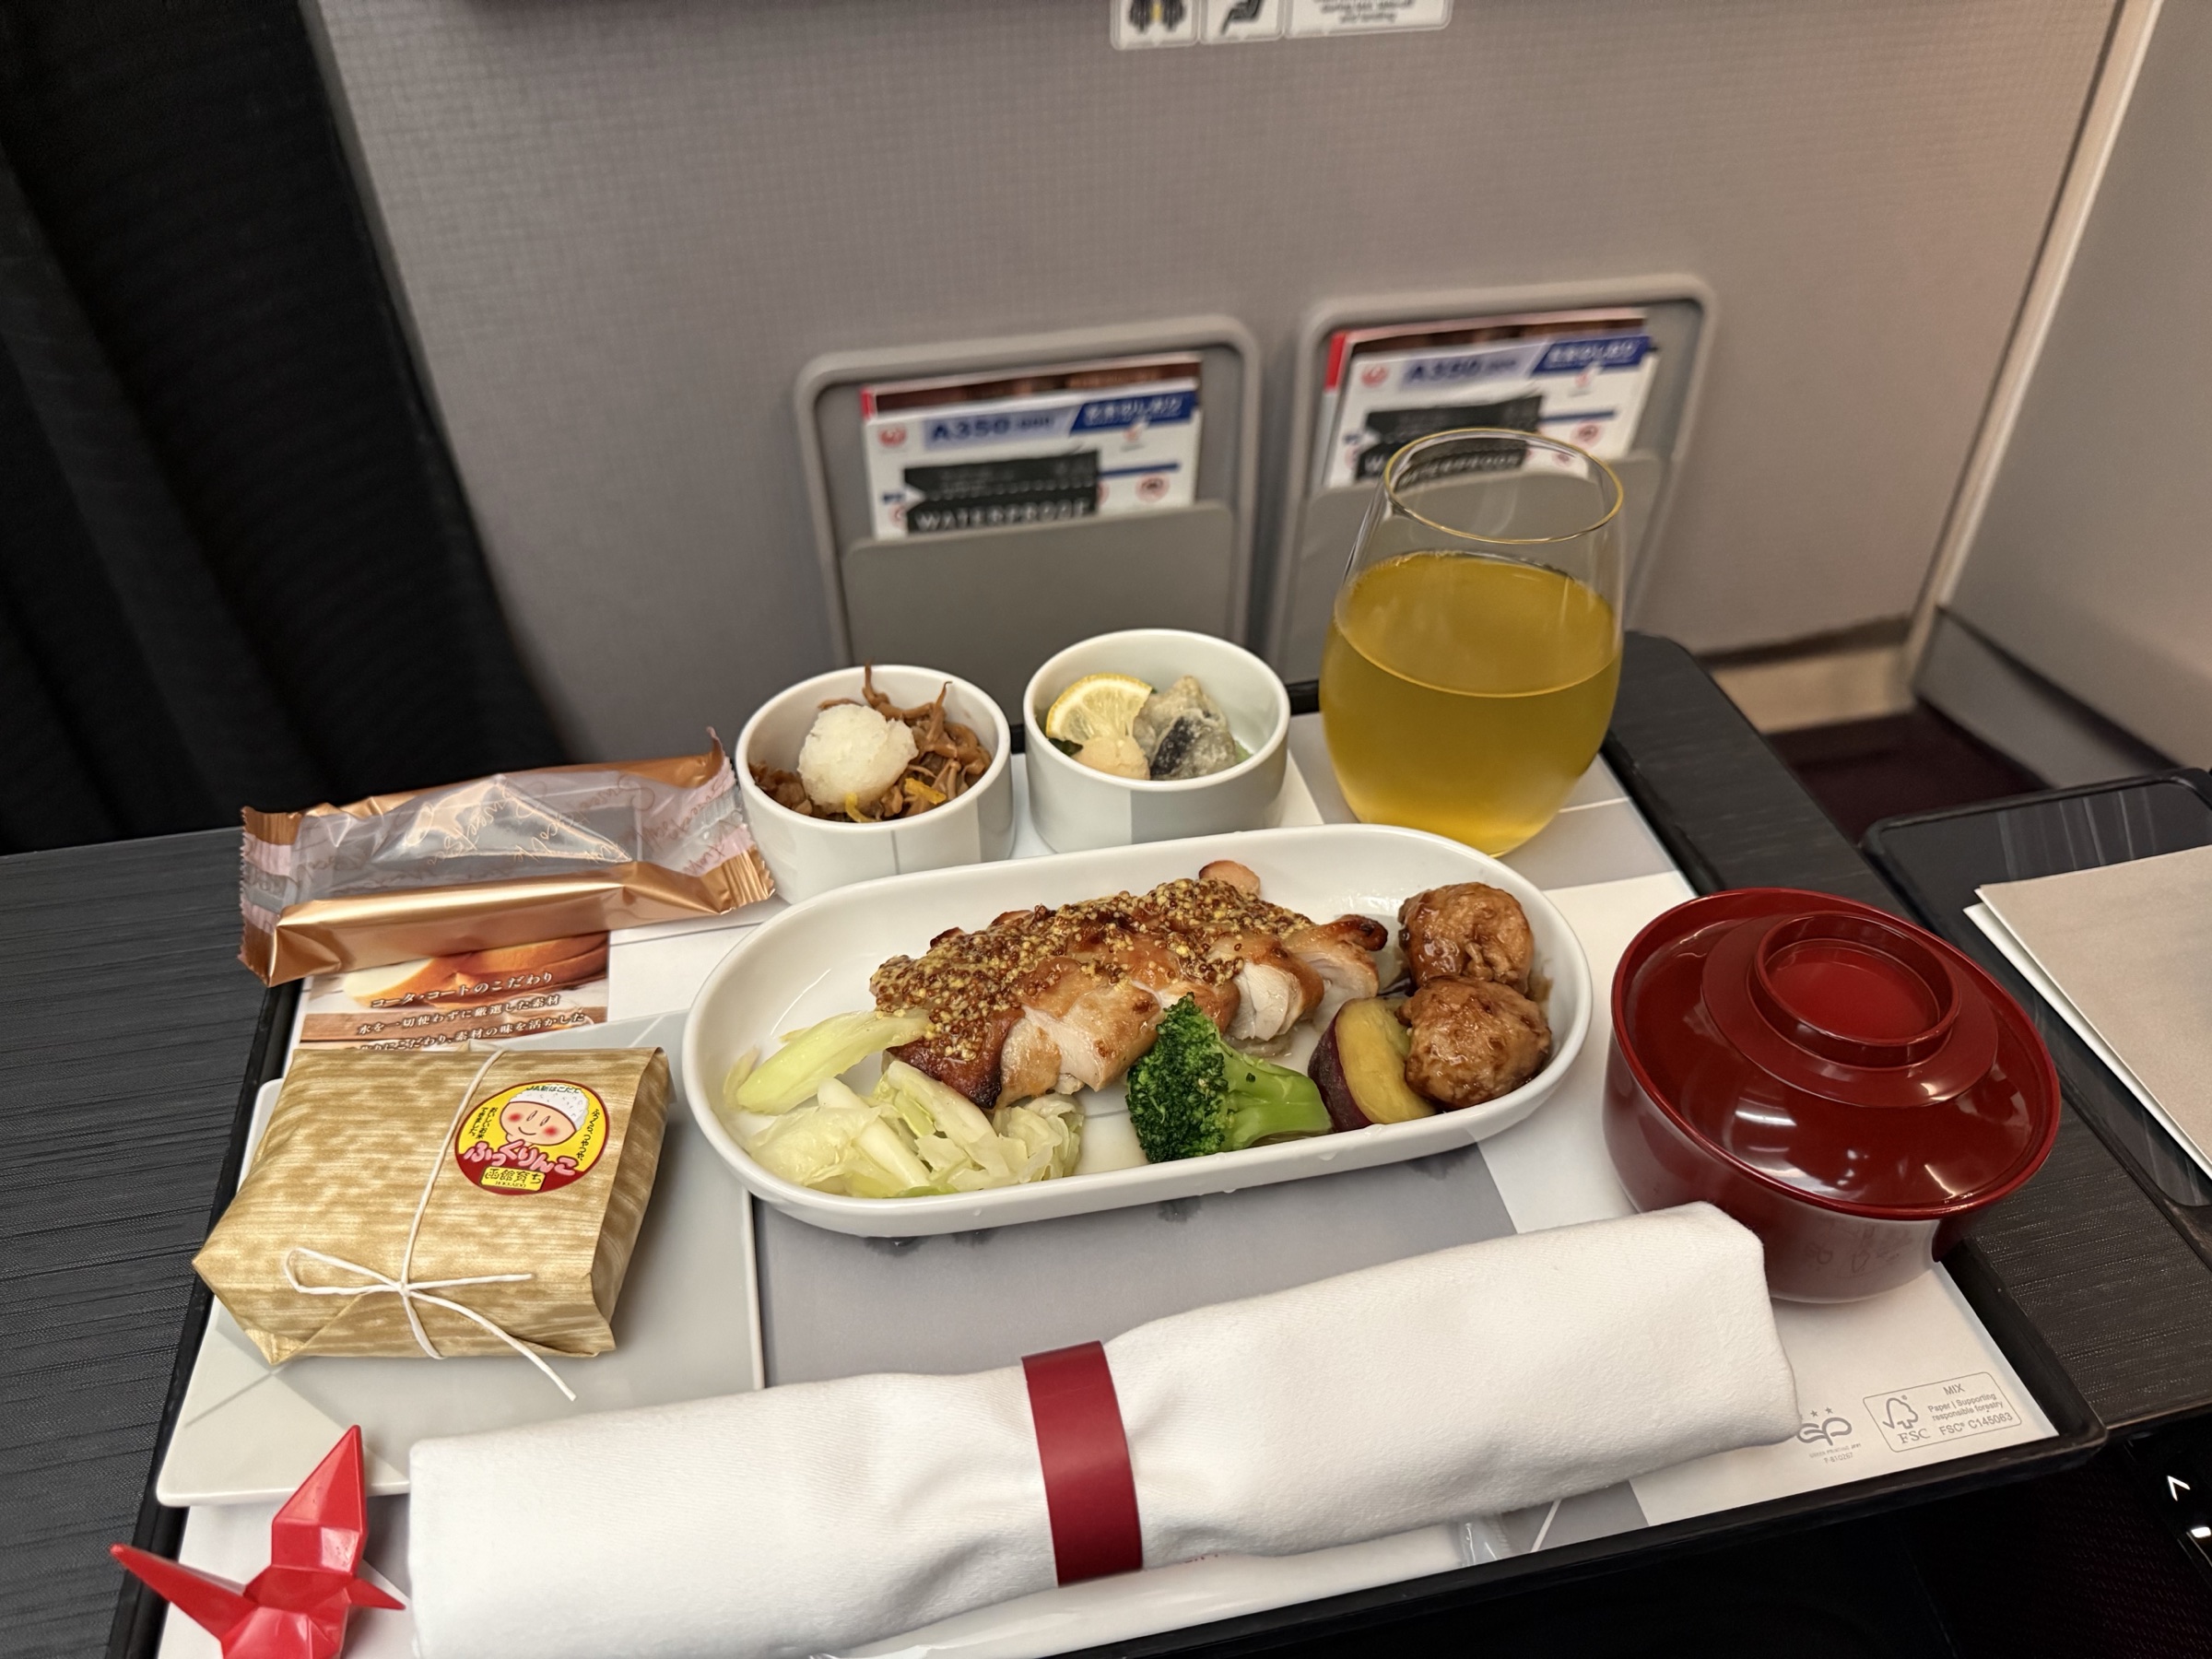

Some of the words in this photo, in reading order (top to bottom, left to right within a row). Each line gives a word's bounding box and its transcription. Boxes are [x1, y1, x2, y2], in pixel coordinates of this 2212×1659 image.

[371, 972, 553, 1008] コータ・コートのこだわり
[358, 994, 560, 1035] 水を一切使わずに厳選した素材
[464, 1139, 578, 1176] ふっくりんこ
[484, 1168, 542, 1184] 函館育ち
[1943, 1383, 1965, 1395] MIX
[1927, 1402, 1951, 1413] Paper
[1956, 1393, 1997, 1406] Supporting
[1932, 1406, 1974, 1421] responsible
[1974, 1401, 2004, 1413] forestry
[1968, 1412, 2013, 1429] C145063
[1897, 1429, 1931, 1444] FSC
